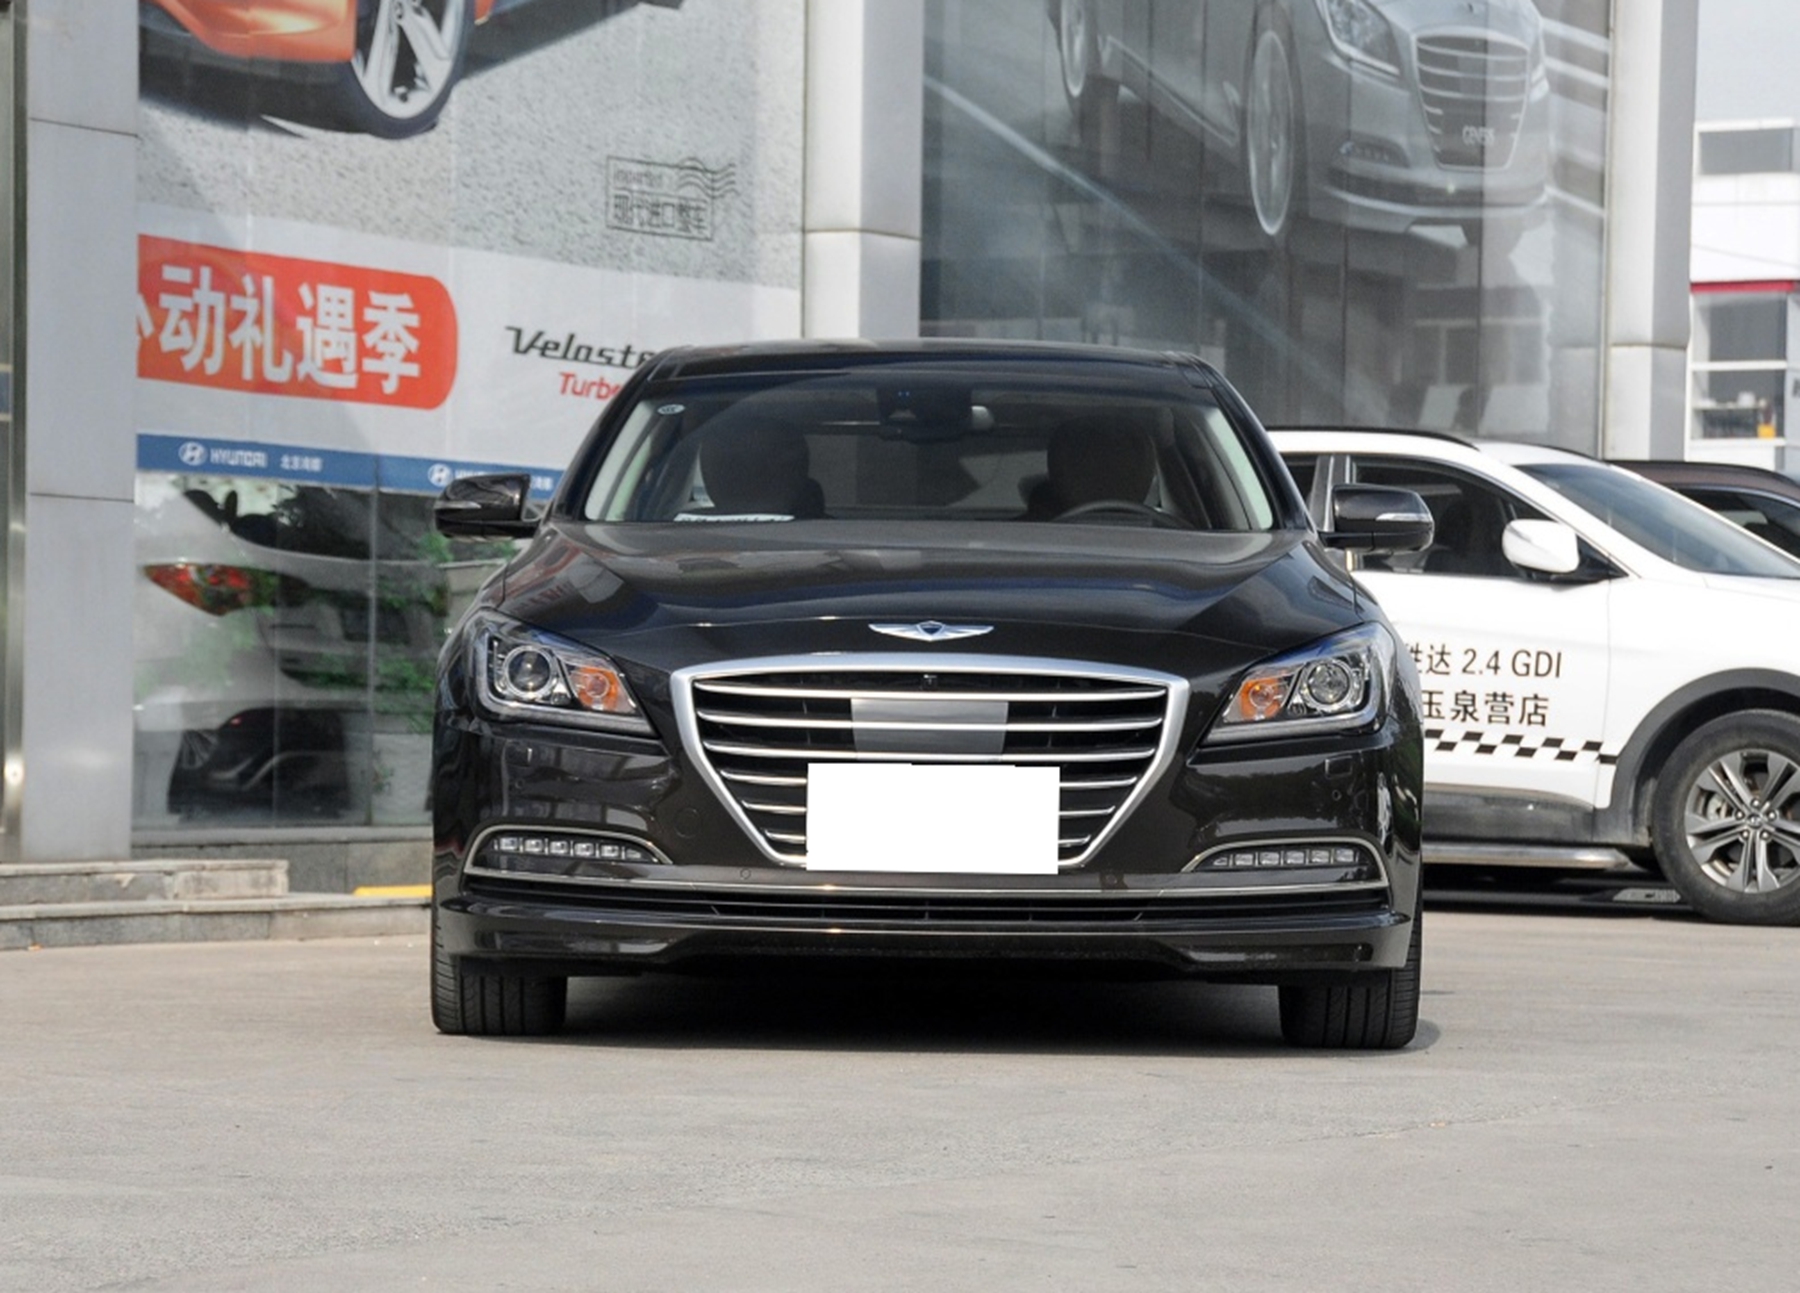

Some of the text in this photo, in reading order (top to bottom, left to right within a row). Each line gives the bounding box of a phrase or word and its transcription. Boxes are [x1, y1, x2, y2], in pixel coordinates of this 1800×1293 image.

[210, 448, 268, 468] HYUNDAI
[1461, 648, 1501, 675] 2.4
[1511, 649, 1562, 678] GDI
[1422, 688, 1549, 728] 玉泉营店
